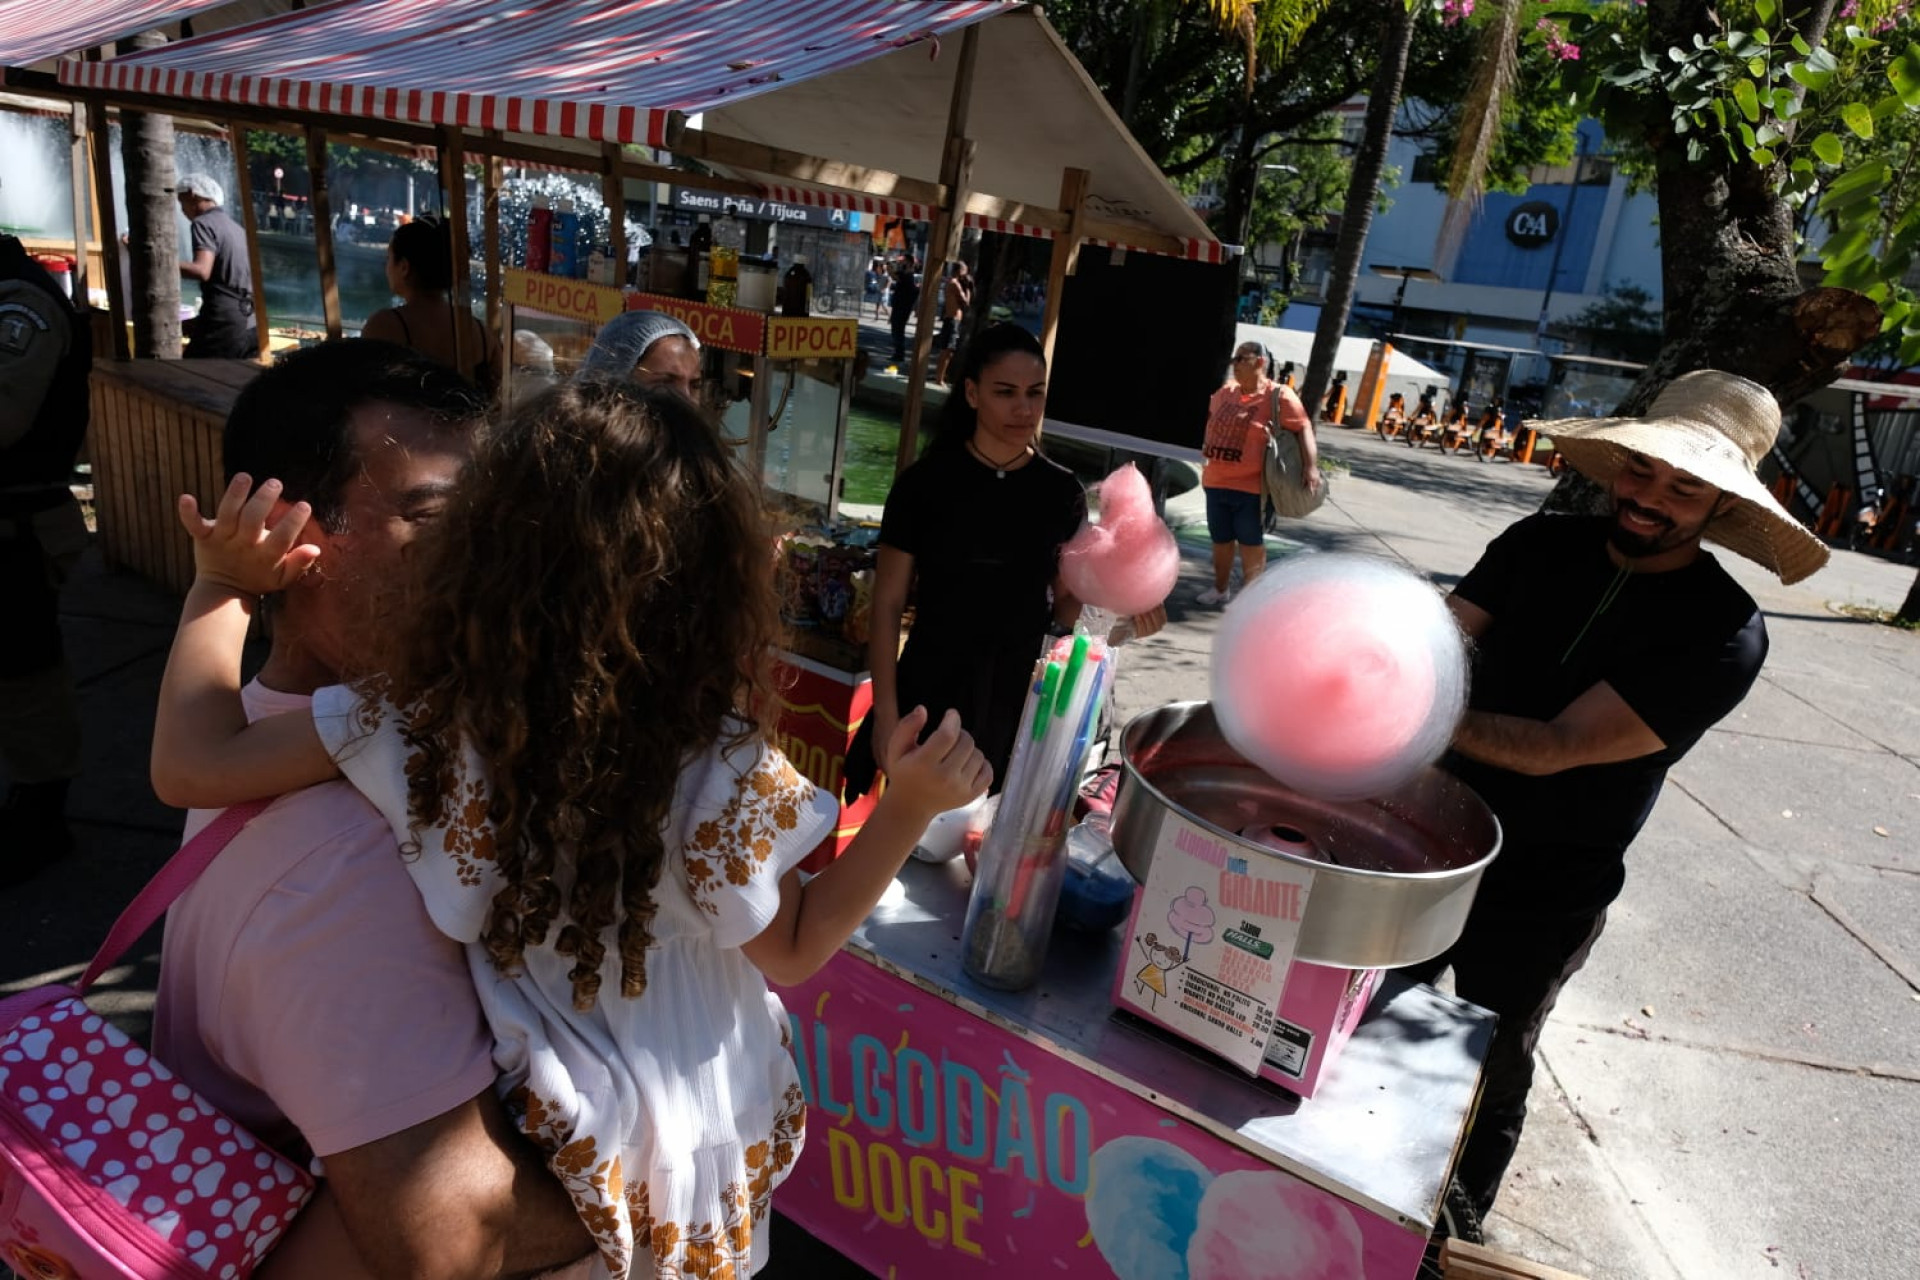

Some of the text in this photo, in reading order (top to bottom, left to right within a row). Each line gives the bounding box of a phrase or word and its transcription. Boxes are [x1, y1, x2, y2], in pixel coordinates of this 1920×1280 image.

[680, 190, 719, 209] Saens
[723, 196, 754, 213] Pña
[769, 203, 807, 221] Tijuca
[526, 278, 599, 316] PIPOCA
[652, 303, 735, 343] POCA
[773, 325, 852, 351] PIPOCA
[1219, 871, 1302, 922] GIGANTE
[1226, 931, 1261, 948] HALLS
[828, 1127, 983, 1255] DOCE
